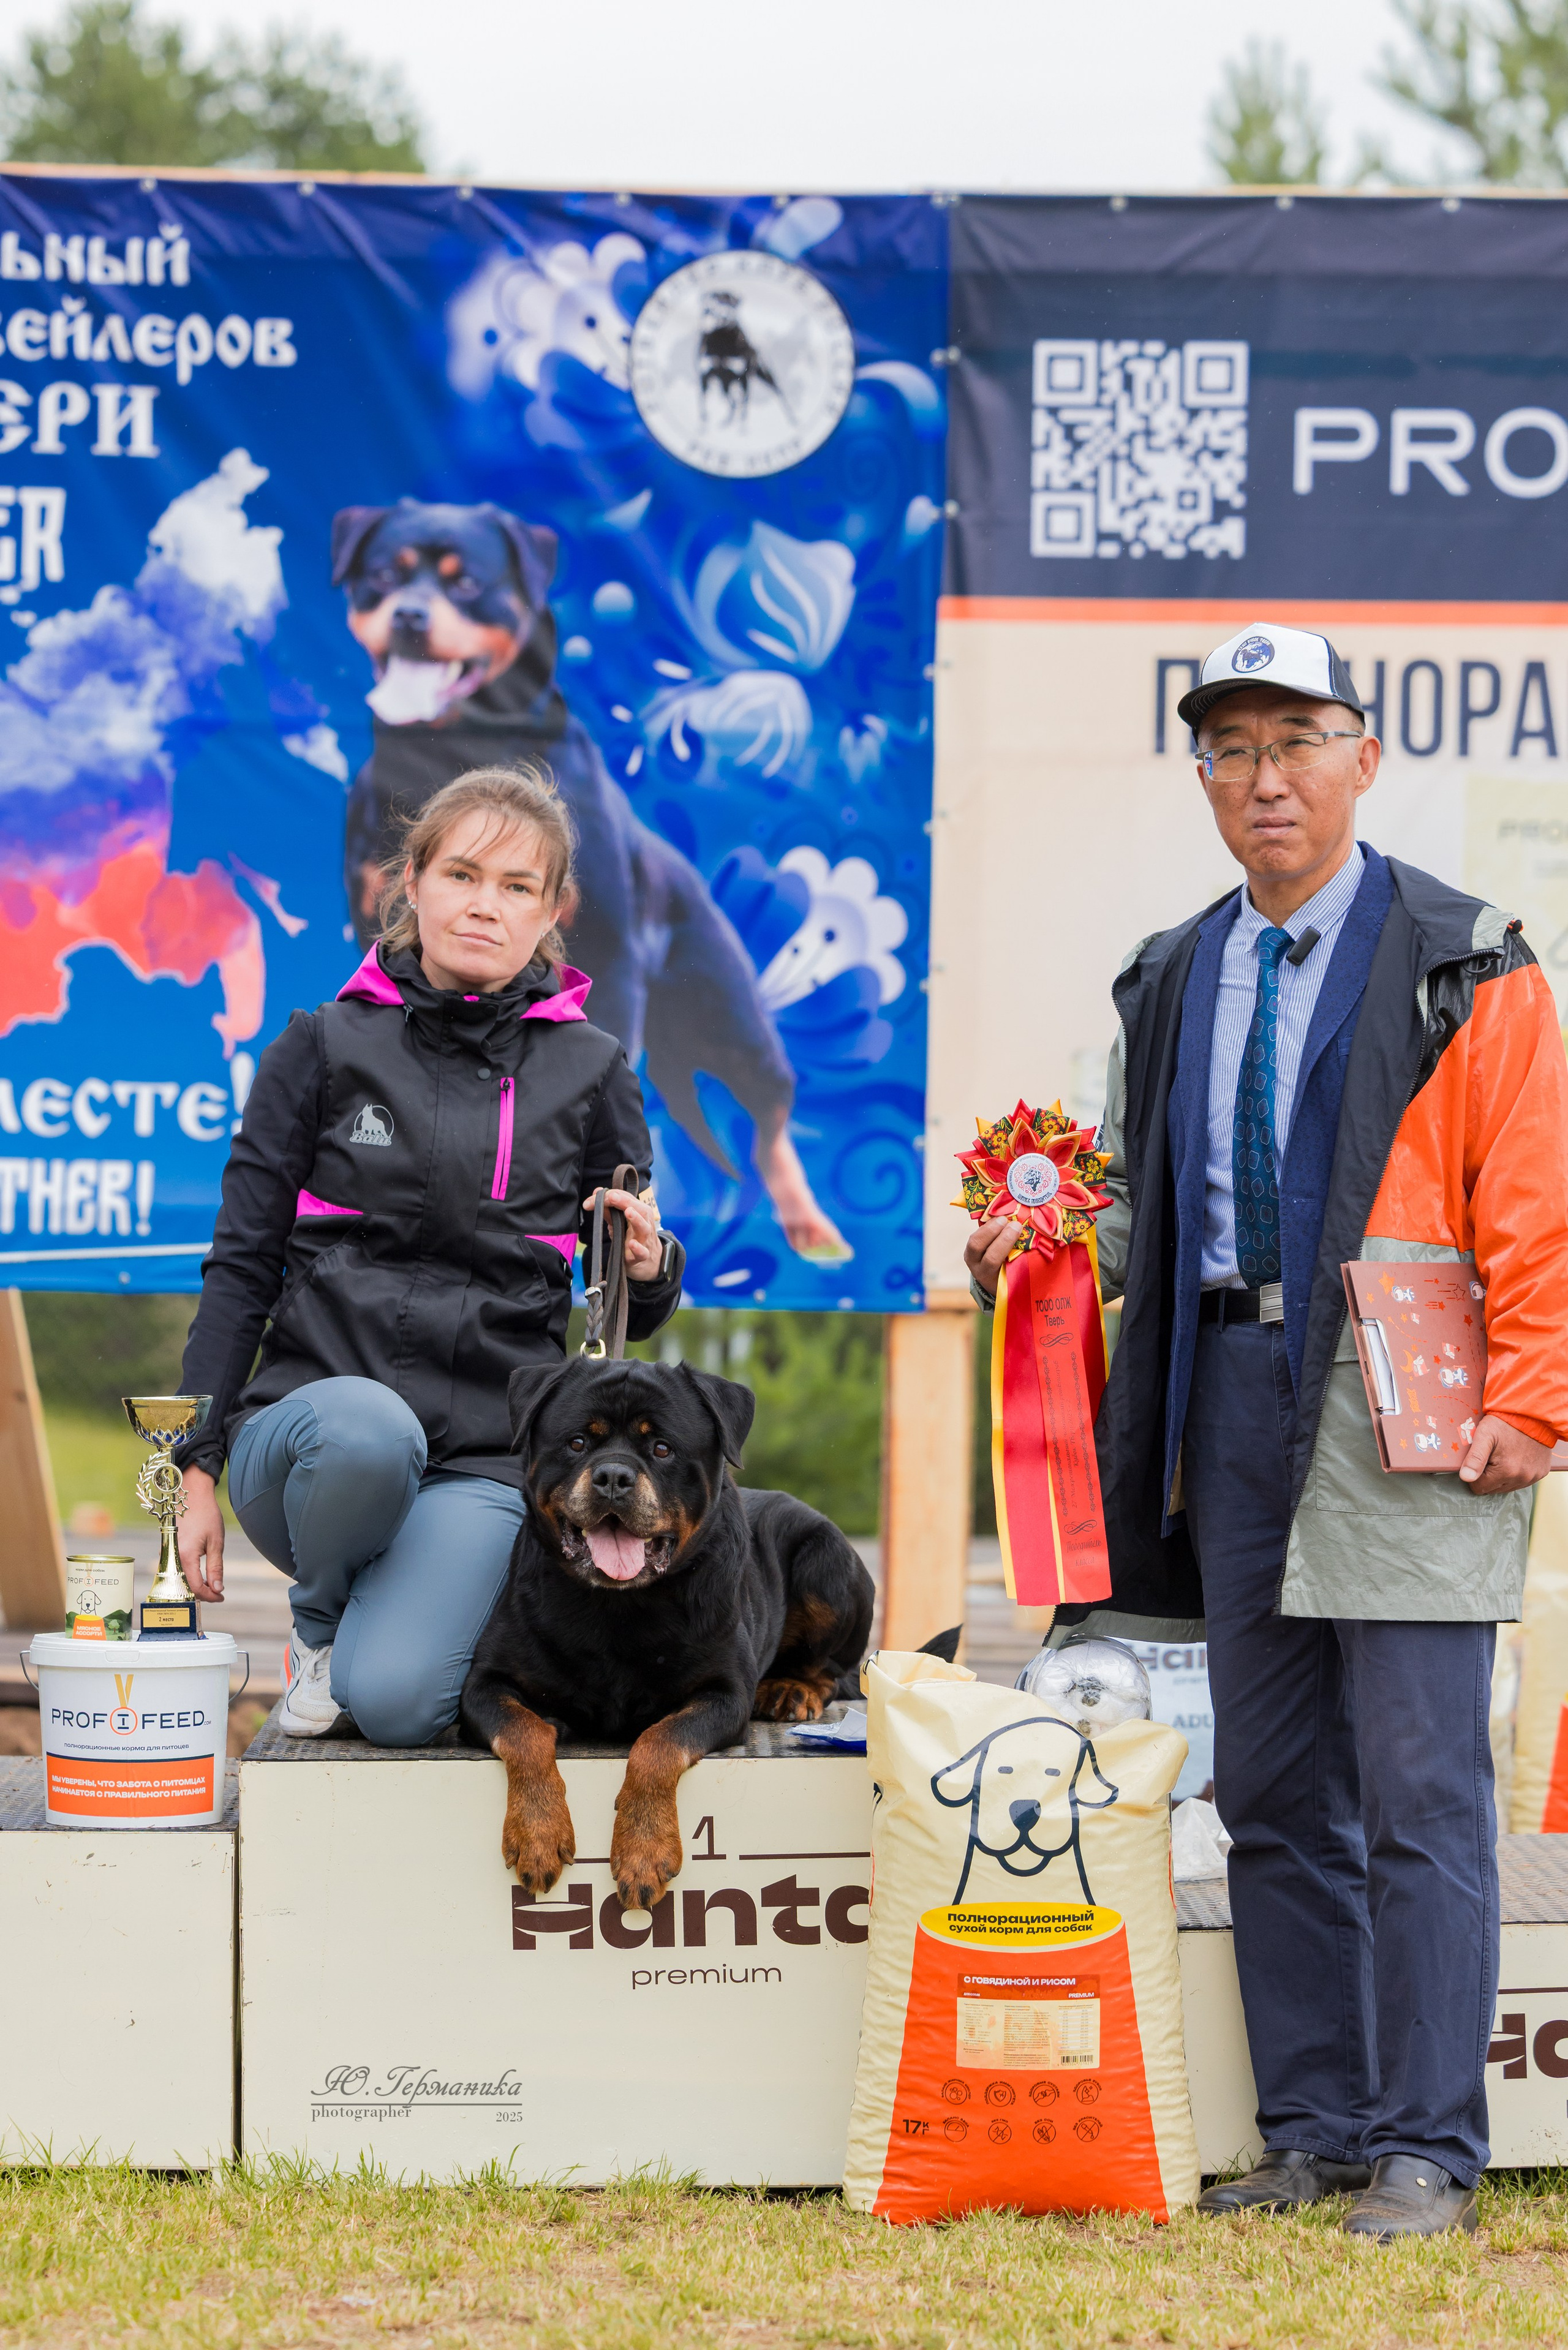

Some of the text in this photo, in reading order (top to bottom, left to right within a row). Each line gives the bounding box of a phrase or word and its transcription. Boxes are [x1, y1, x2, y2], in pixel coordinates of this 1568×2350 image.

[0, 295, 297, 385] ейлеров
[1293, 407, 1568, 499] PRO
[1156, 659, 1558, 758] ПНОРА
[351, 1130, 392, 1146] Balu
[64, 1742, 121, 1751] полнорационные
[61, 1777, 96, 1787] УВЕРЕНЫ,
[161, 1777, 205, 1787] ПИТОМЦАХ
[52, 1785, 95, 1797] НАЧИНАЕТСЯ
[104, 1790, 170, 1798] ПРАВИЛЬНОГО
[171, 1787, 206, 1797] ПИТАНИЯ
[692, 1816, 727, 1860] 1
[948, 1910, 1094, 1925] полнорационный
[949, 1923, 1093, 1935] сухой корм для собак
[632, 1964, 782, 1990] premium
[972, 1976, 1030, 1986] ГОВЯДИНОЙ
[902, 2119, 921, 2134] 17
